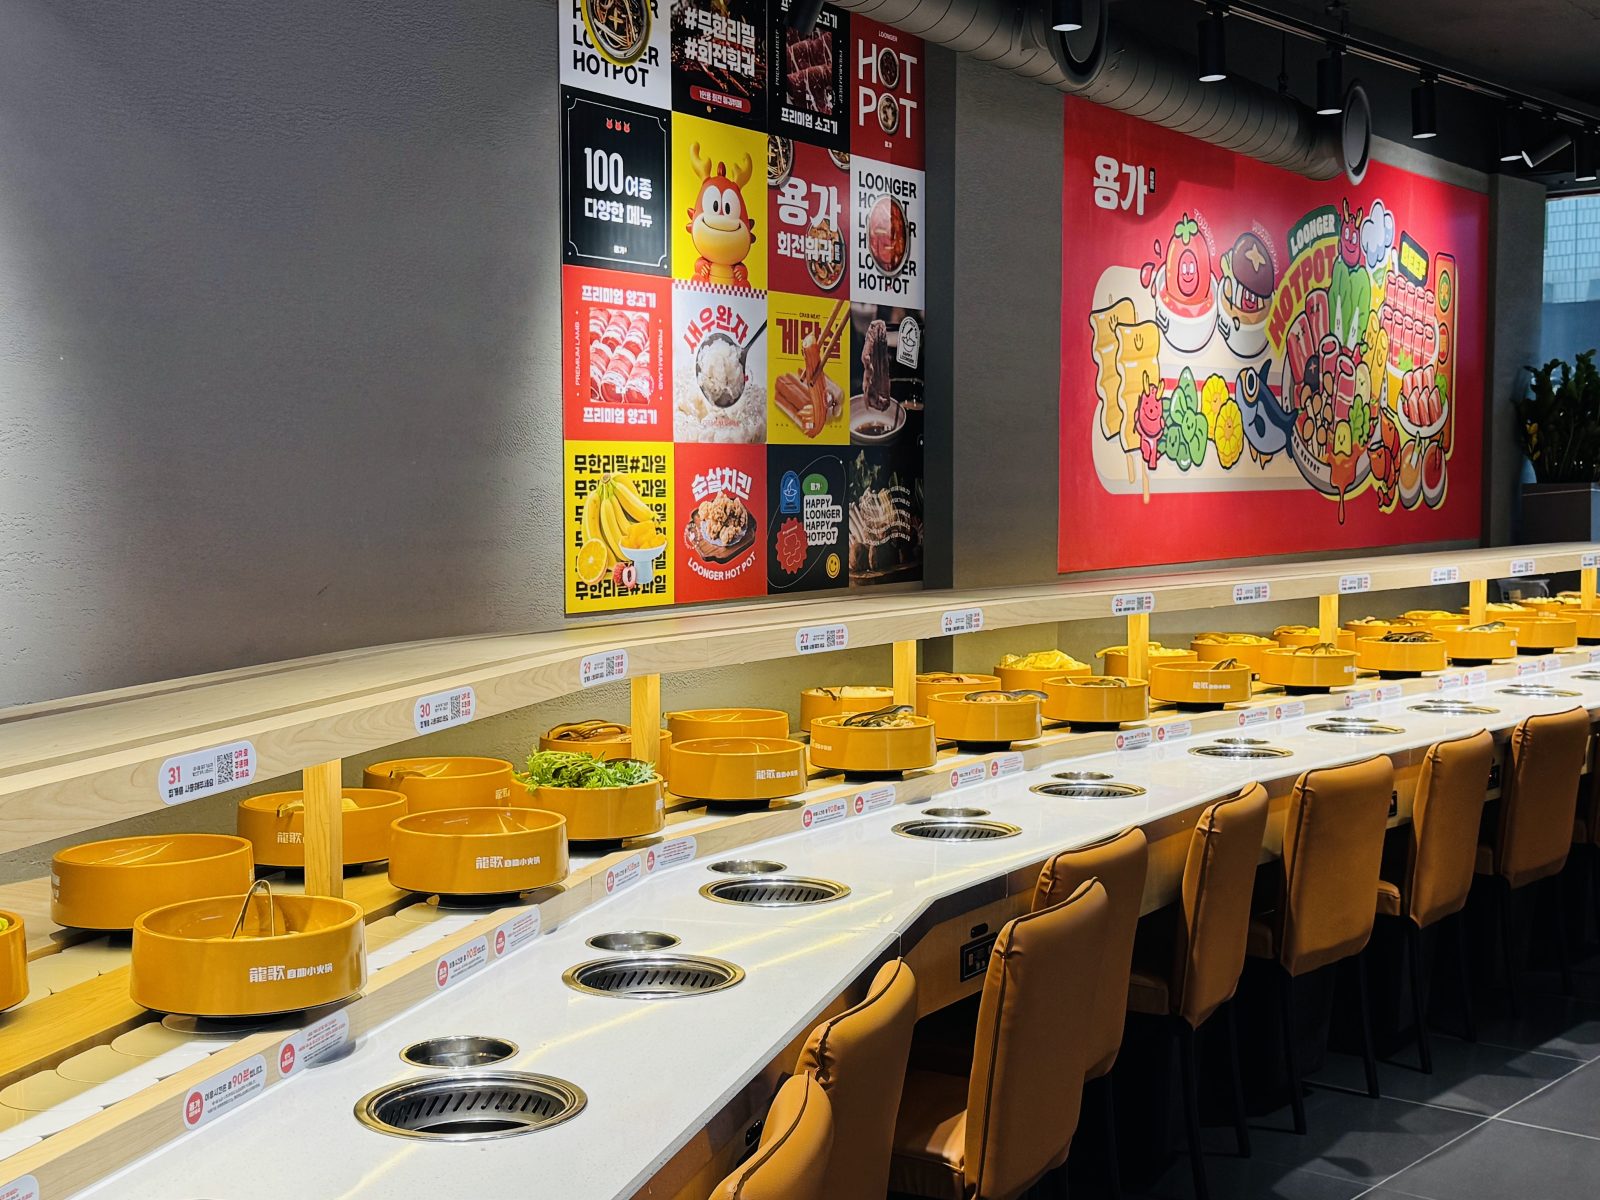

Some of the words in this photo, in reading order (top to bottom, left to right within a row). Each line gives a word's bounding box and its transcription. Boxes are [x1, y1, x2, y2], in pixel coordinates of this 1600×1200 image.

[573, 50, 649, 87] HOTPOT
[781, 107, 813, 129] 프리미엄
[814, 117, 838, 135] 소고기
[859, 171, 917, 199] LOONGER
[1093, 155, 1148, 216] 용가
[584, 197, 624, 224] 다양한
[626, 204, 653, 228] 메뉴
[777, 176, 841, 233] 용가
[1290, 213, 1335, 256] LOONGER
[859, 272, 909, 295] HOTPOT
[581, 285, 624, 305] 프리미엄
[625, 290, 657, 308] 양고기
[1268, 244, 1337, 348] HOTPOT
[683, 304, 749, 355] 새우완자
[583, 406, 625, 424] 프리미엄
[627, 408, 658, 425] 양고기
[574, 453, 666, 474] 무한리필#과일
[691, 467, 752, 502] 순살치킨
[805, 498, 832, 509] HAPPY
[805, 509, 841, 520] LOONGER
[805, 520, 831, 531] HAPPY
[806, 530, 837, 542] HOTPOT
[687, 556, 725, 581] LOONGER
[724, 565, 741, 580] HOT
[741, 551, 756, 573] POT
[945, 616, 953, 626] 26
[800, 633, 809, 644] 27
[420, 702, 431, 718] 30
[168, 765, 181, 785] 31
[249, 965, 286, 983] 龍歌
